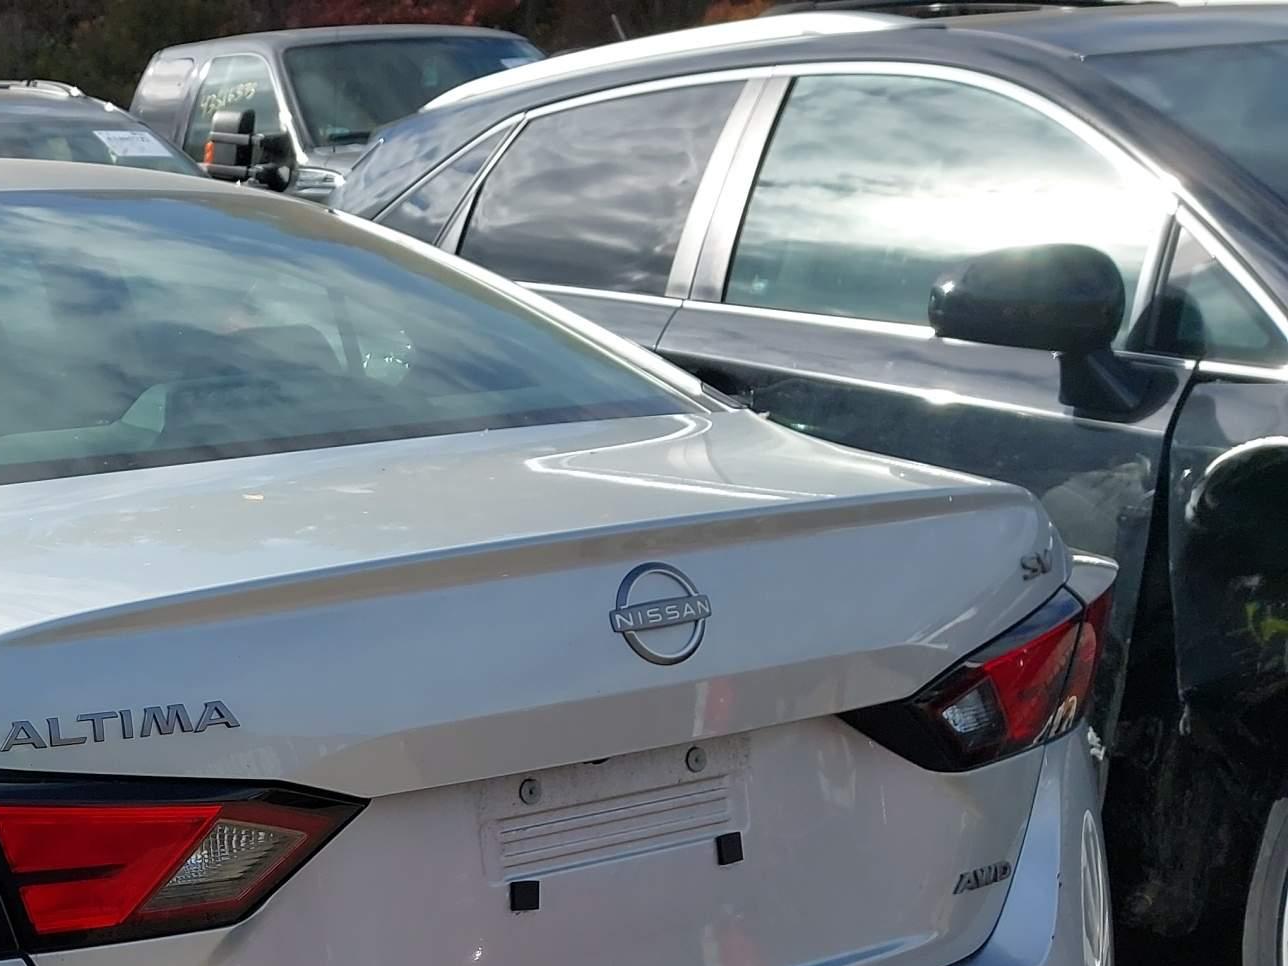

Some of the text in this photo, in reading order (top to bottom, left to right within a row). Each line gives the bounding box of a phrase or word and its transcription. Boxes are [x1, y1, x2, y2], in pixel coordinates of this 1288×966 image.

[1020, 549, 1051, 581] SV
[614, 599, 710, 629] NISSAN
[0, 700, 241, 752] ALTIMA
[952, 860, 1012, 895] AWD
